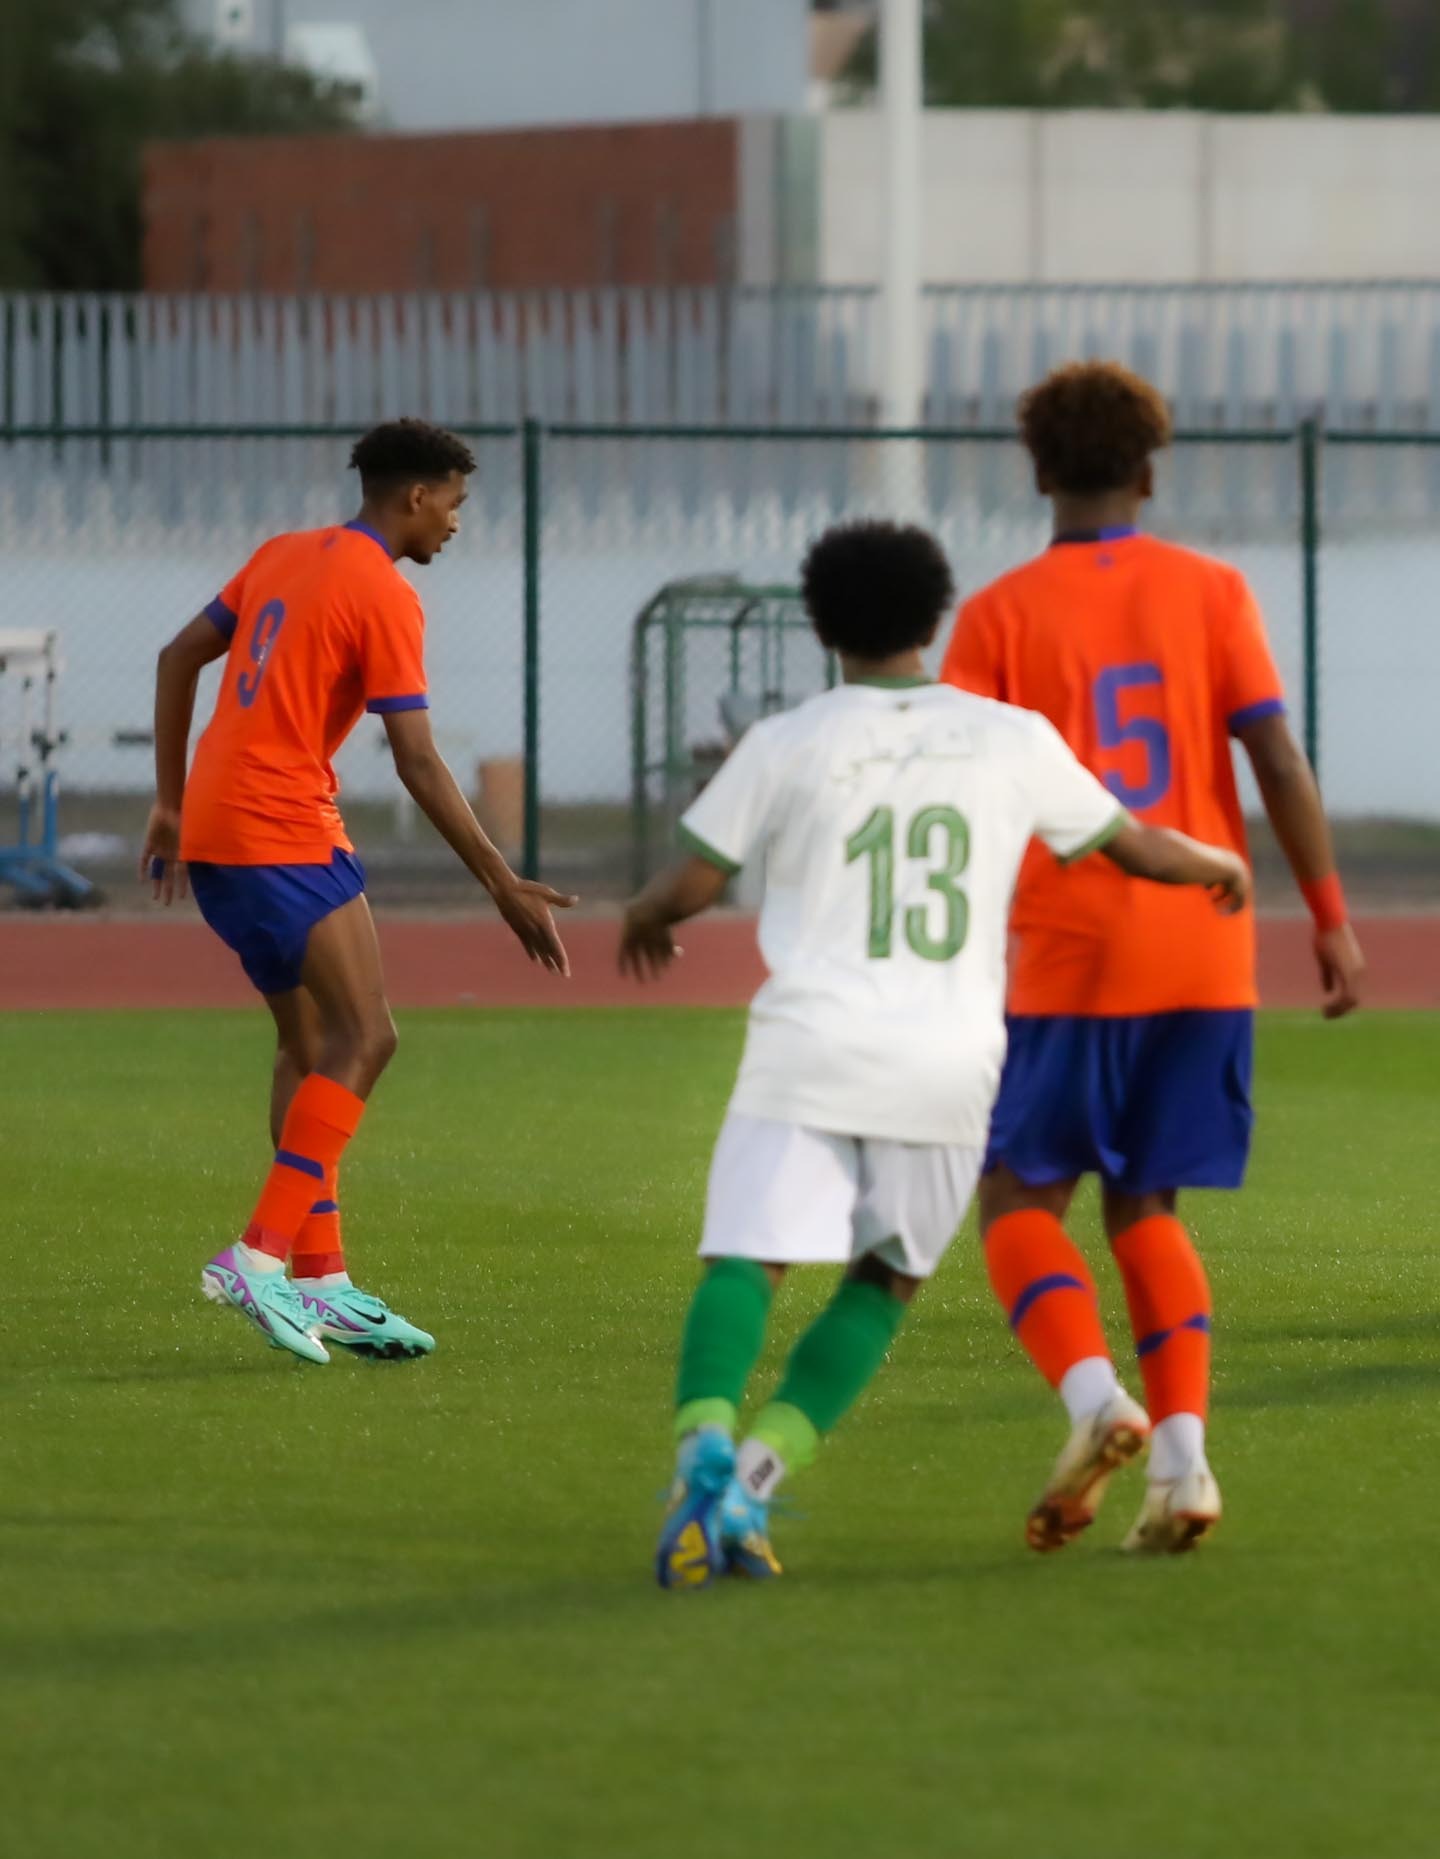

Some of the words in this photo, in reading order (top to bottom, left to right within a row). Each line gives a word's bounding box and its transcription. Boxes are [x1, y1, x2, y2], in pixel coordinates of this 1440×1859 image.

[237, 596, 286, 709] 9
[1093, 661, 1174, 810] 5
[845, 804, 971, 962] 13
